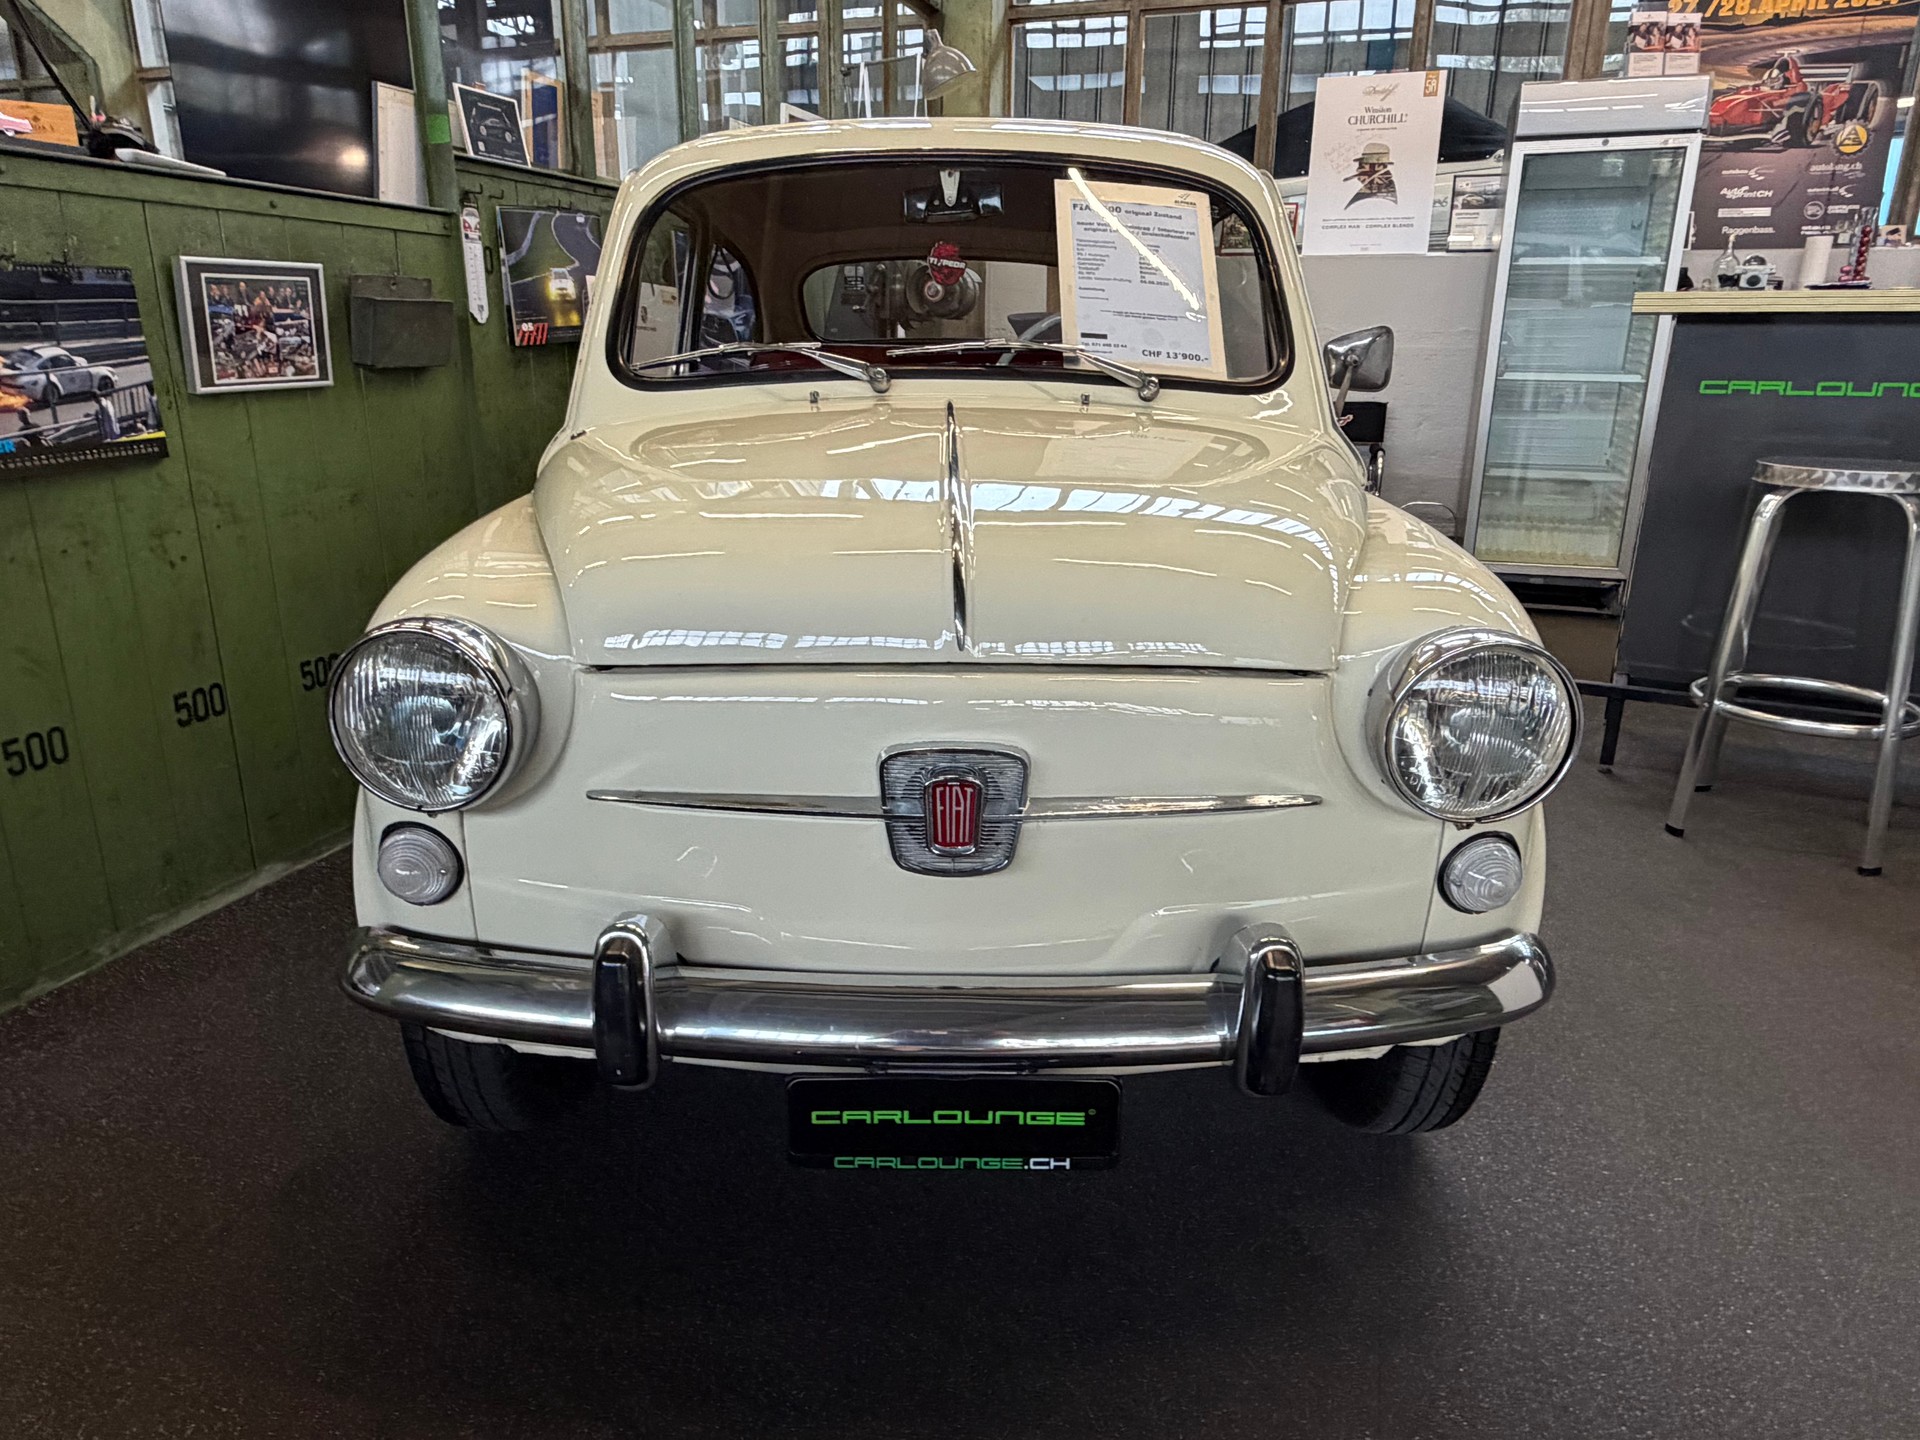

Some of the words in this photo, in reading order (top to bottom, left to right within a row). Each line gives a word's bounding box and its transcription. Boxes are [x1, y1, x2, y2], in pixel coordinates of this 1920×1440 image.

[1072, 203, 1092, 212] FIA
[1153, 211, 1183, 220] Zustand
[1141, 349, 1162, 358] CHF
[172, 682, 227, 728] 500
[2, 726, 69, 777] 500
[936, 787, 974, 843] FIAT
[811, 1110, 1086, 1126] CARLOUNGE
[833, 1157, 1071, 1170] CARLOUNGE.CH
